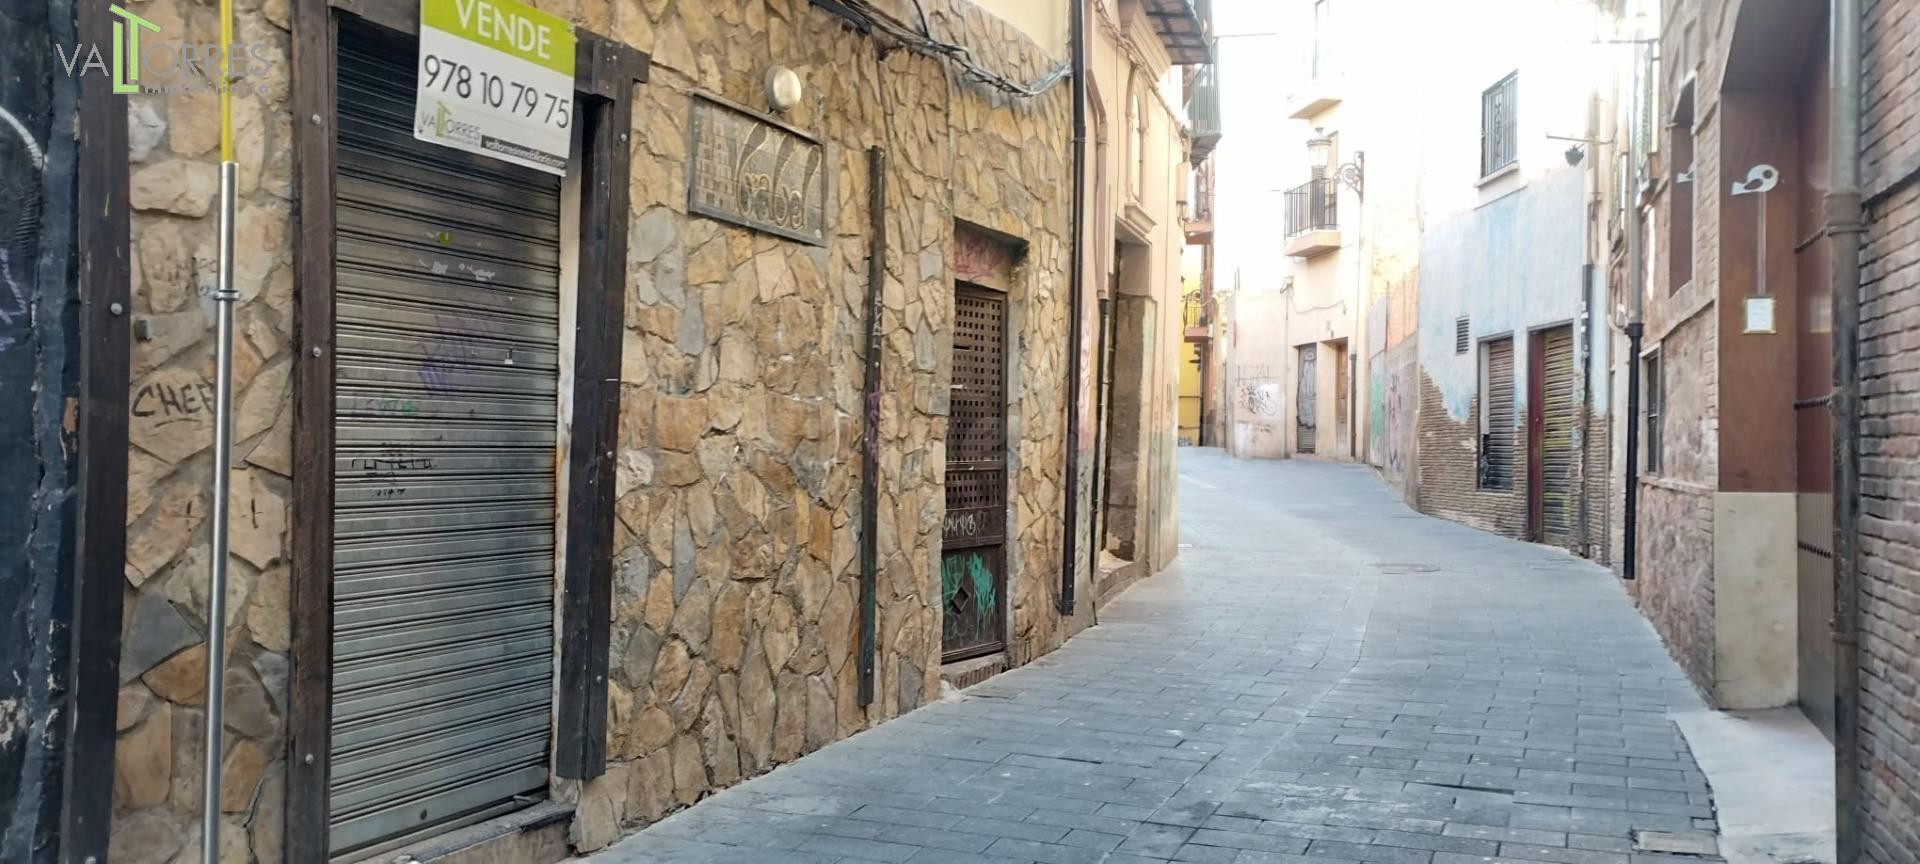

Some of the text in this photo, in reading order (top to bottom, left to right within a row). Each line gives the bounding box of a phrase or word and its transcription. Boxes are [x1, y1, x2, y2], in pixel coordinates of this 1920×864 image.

[456, 0, 551, 59] VENDE
[424, 54, 569, 129] 978 10 79 75
